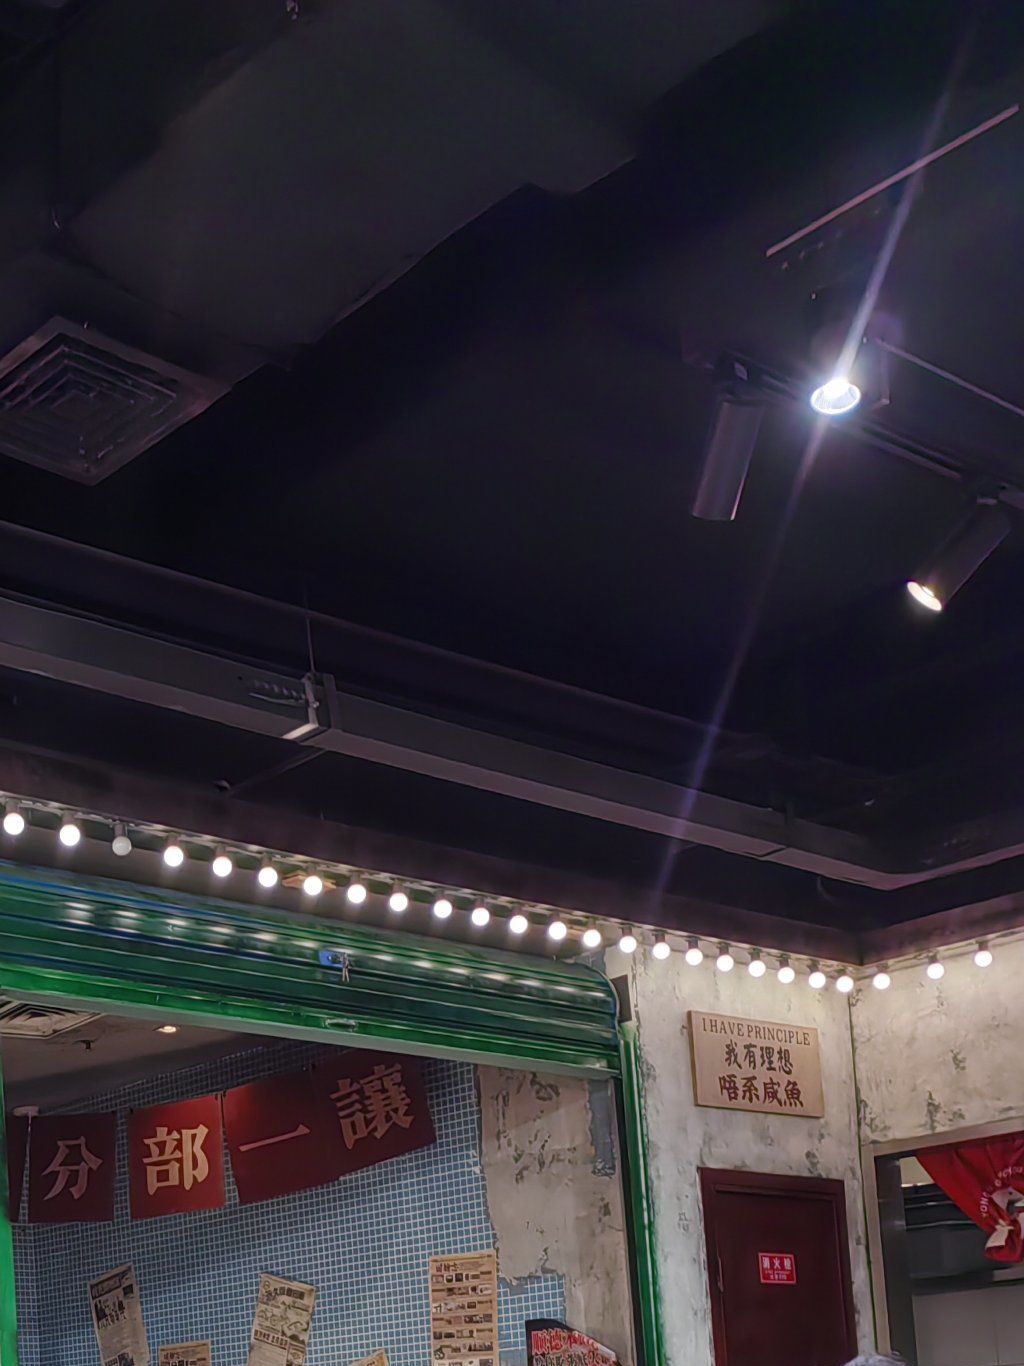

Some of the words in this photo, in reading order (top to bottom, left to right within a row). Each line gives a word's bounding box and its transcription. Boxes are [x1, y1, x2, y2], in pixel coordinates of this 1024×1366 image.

[709, 1018, 745, 1037] HAVE
[746, 1022, 811, 1046] PRINCIPLE
[724, 1039, 794, 1076] 我有理想
